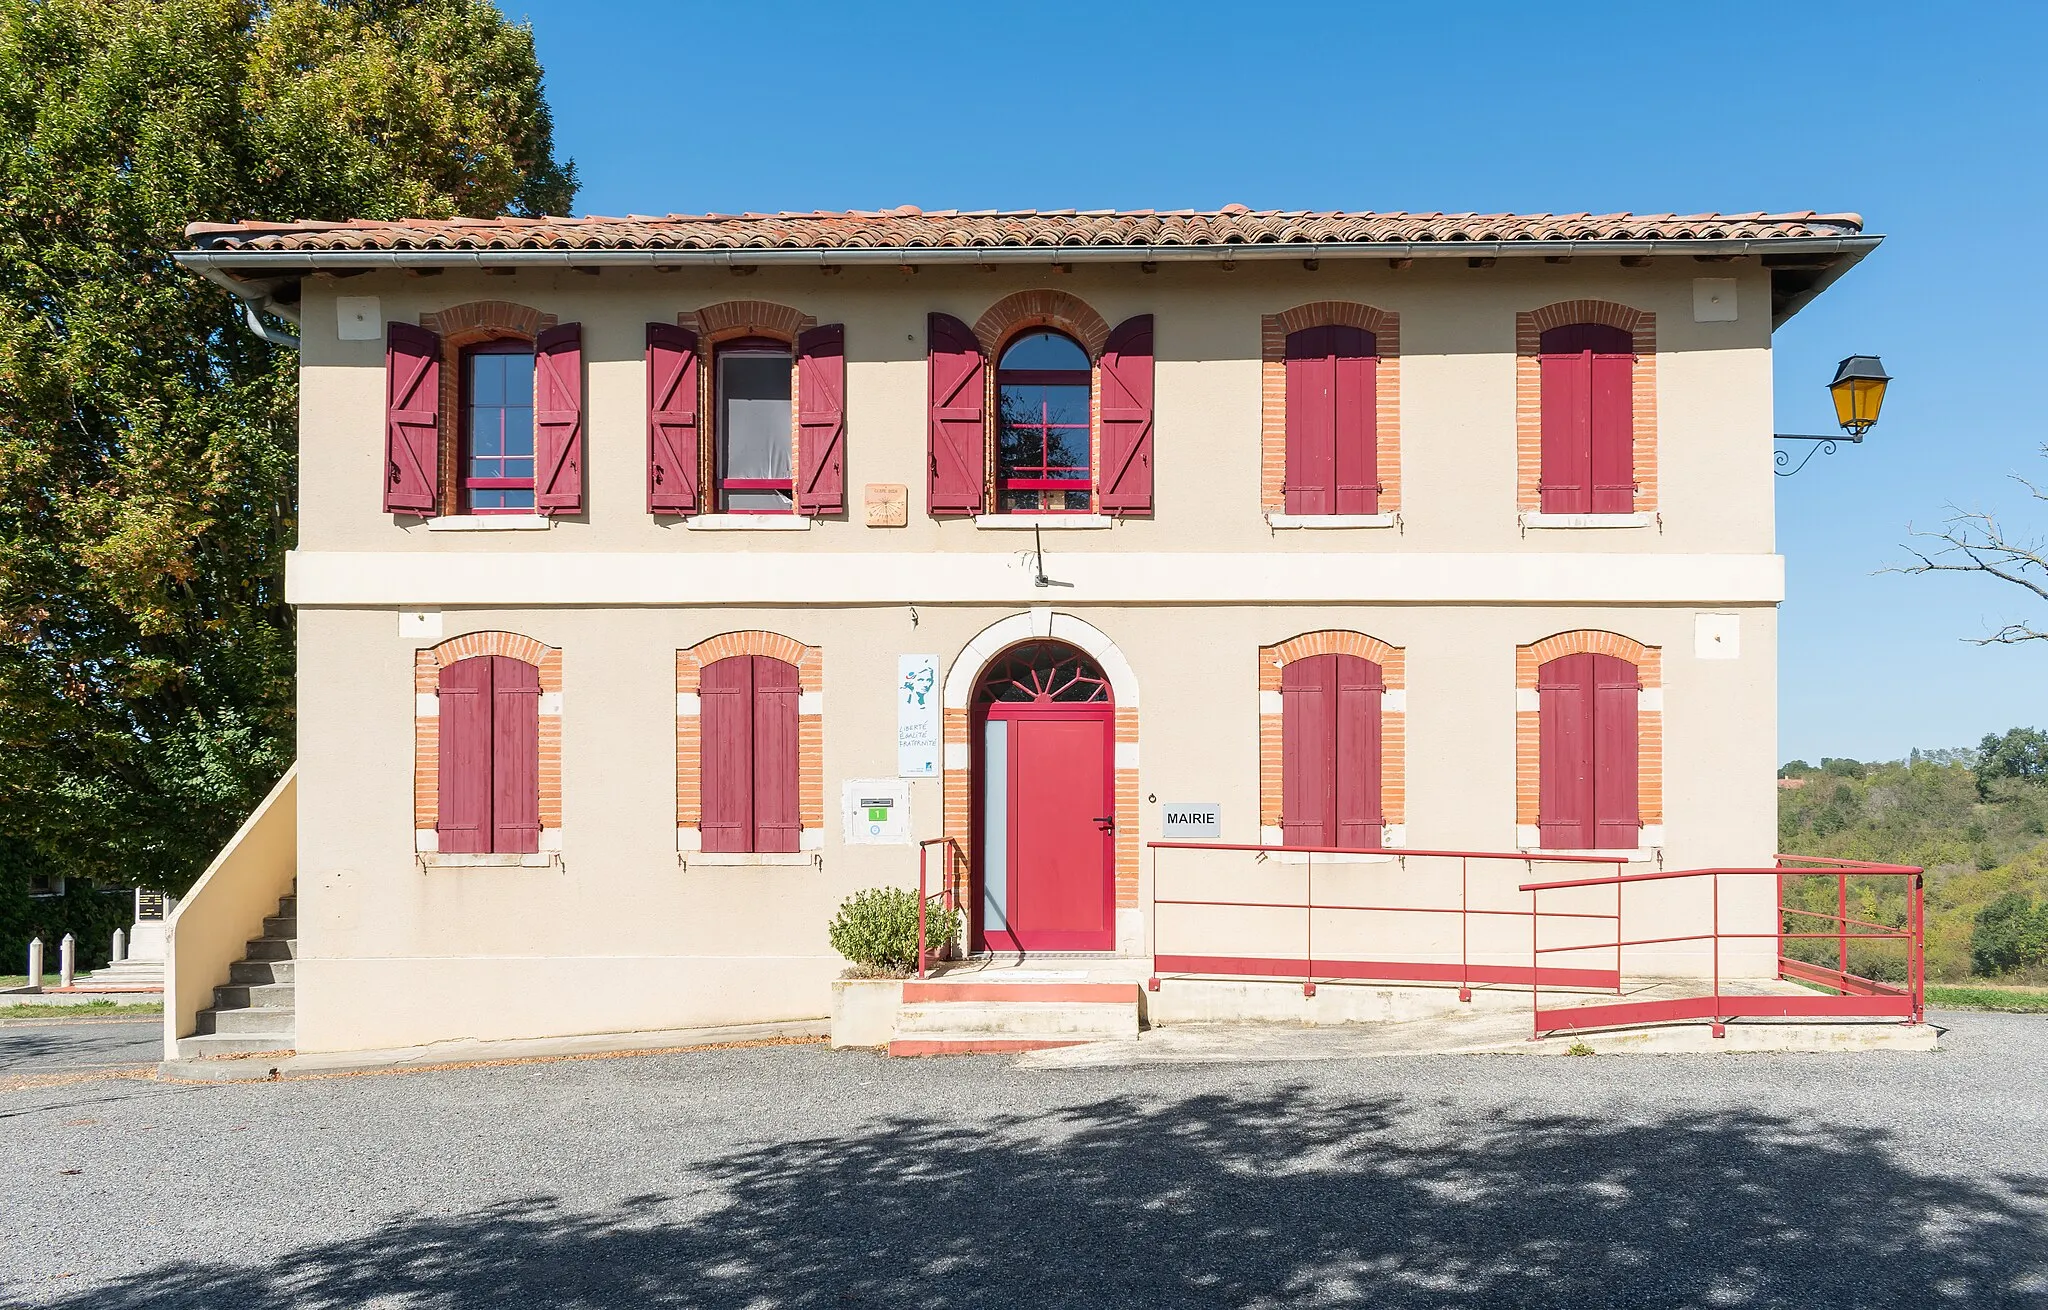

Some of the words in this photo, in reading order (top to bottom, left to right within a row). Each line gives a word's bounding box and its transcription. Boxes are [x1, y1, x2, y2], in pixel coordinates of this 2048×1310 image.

[899, 720, 929, 732] LIBERTÉ
[874, 810, 880, 819] 1
[1167, 813, 1215, 824] MAIRIE
